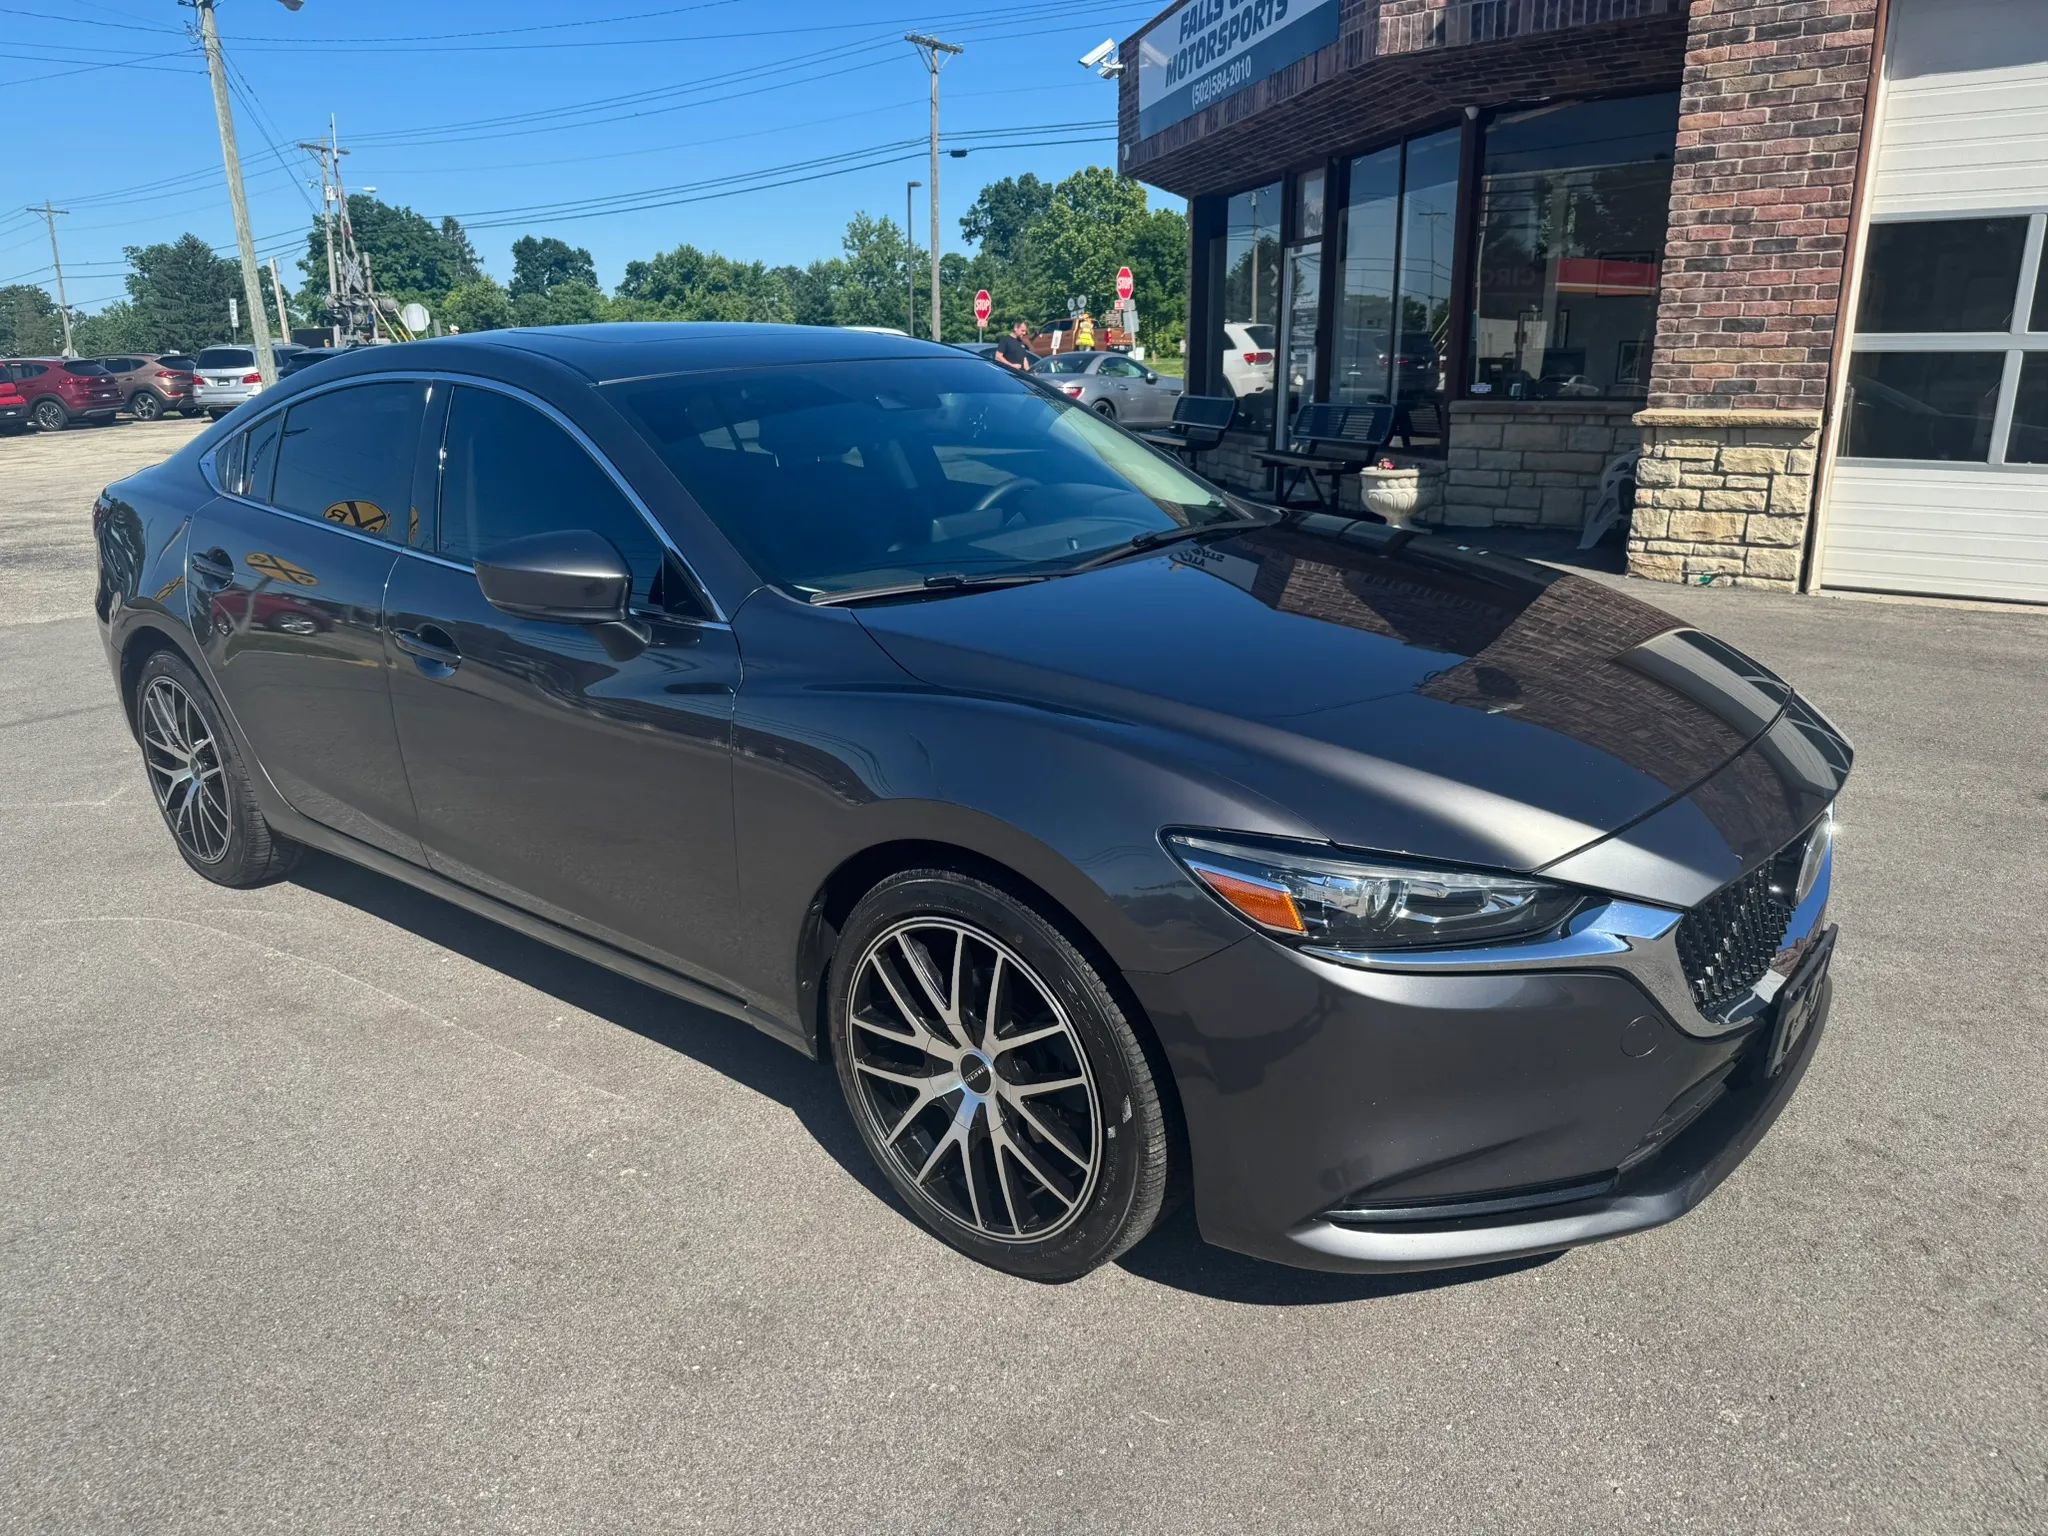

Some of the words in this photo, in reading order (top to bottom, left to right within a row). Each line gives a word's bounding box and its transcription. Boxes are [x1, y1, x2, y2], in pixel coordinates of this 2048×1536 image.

[1165, 0, 1288, 88] MOTORSPORTS
[1192, 55, 1251, 109] (502)584-2010
[976, 299, 990, 311] STOP
